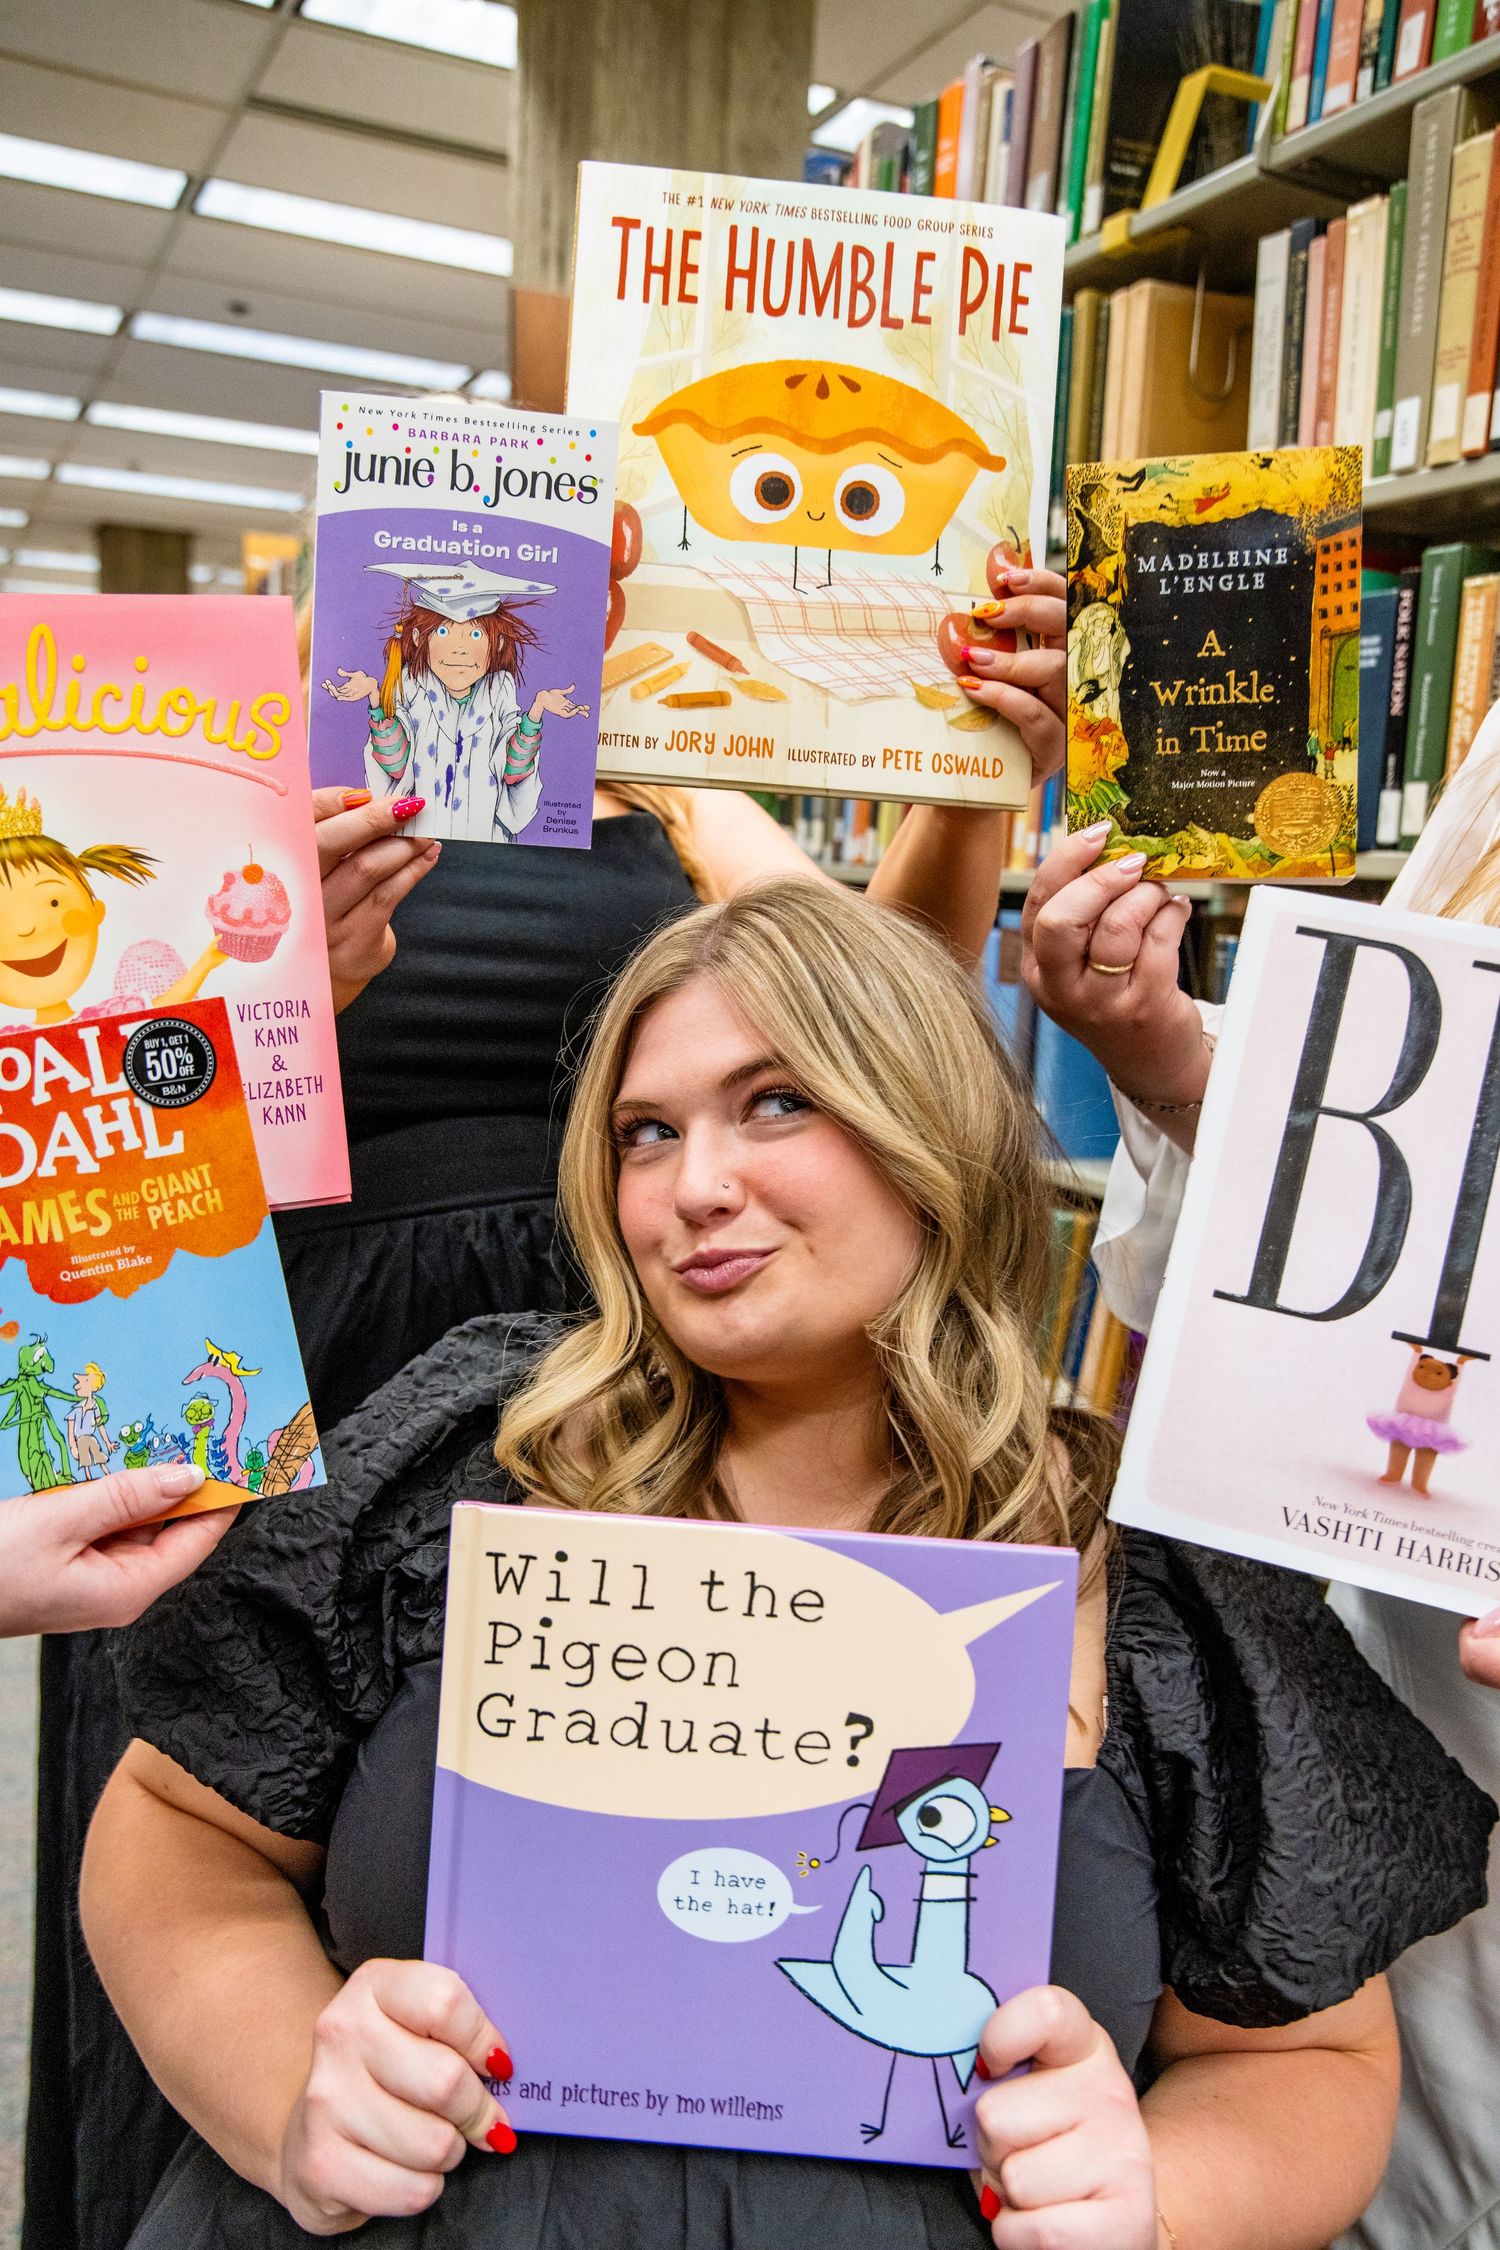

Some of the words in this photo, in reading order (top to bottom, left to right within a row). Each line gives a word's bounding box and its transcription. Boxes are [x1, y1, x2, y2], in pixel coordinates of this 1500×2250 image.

[662, 191, 681, 206] THE
[687, 195, 704, 208] #1
[710, 196, 734, 211] NEW
[739, 199, 768, 215] YORK
[773, 203, 807, 218] TIMES
[810, 206, 878, 226] BESTSELLING
[883, 214, 912, 229] FOOD
[917, 217, 955, 234] GROUP
[959, 222, 994, 239] SERIES
[611, 216, 702, 306] THE
[724, 224, 936, 330] HUMBLE
[958, 246, 1033, 342] PIE
[358, 406, 383, 416] New
[389, 409, 417, 420] York
[422, 412, 459, 424] Times
[464, 417, 536, 434] Bestselling
[541, 424, 581, 437] Series
[408, 427, 482, 445] BARBARA
[489, 436, 530, 450] PARK
[333, 440, 435, 494] junie
[450, 448, 480, 493] b.
[452, 519, 468, 533] Is
[472, 523, 484, 535] a
[373, 530, 510, 559] Graduation
[516, 543, 559, 564] Girl
[1137, 547, 1290, 574] MADELEINE
[1196, 629, 1226, 658] A
[1150, 670, 1276, 708] Wrinkle
[597, 732, 640, 749] RITTEN
[645, 736, 659, 750] BY
[664, 729, 716, 756] JORY
[723, 734, 775, 760] JOHN
[1155, 728, 1181, 755] in
[1190, 720, 1268, 753] Time
[787, 747, 857, 768] ILLUSTRATED
[861, 754, 876, 768] BY
[882, 748, 924, 771] PETE
[931, 753, 1004, 779] OSWALD
[1200, 768, 1219, 778] Now
[1171, 780, 1194, 791] Major
[1196, 780, 1226, 789] Motion
[1227, 779, 1256, 788] Picture
[543, 801, 581, 809] Illustrated
[543, 825, 579, 834] Brunkus
[546, 816, 577, 825] Denise
[236, 999, 311, 1023] VICTORIA
[144, 1038, 159, 1049] BUY
[160, 1037, 168, 1048] 1,
[169, 1034, 183, 1046] GET
[184, 1034, 189, 1043] 1
[254, 1025, 299, 1048] KANN
[0, 1019, 154, 1108] OAL
[145, 1046, 194, 1081] 50%
[179, 1064, 195, 1077] OFF
[271, 1054, 288, 1072] &
[162, 1084, 187, 1096] B&N
[263, 1103, 307, 1125] KANN
[0, 1097, 184, 1189] DAHL
[112, 1191, 140, 1209] AND
[141, 1163, 211, 1204] GIANT
[115, 1207, 140, 1222] THE
[146, 1188, 224, 1230] PEACH
[60, 1261, 115, 1282] Quentin
[117, 1254, 153, 1271] Blake
[70, 1245, 122, 1265] Illustrated
[123, 1244, 136, 1256] by
[1281, 1505, 1385, 1552] VASHTI
[1312, 1496, 1338, 1511] New
[1341, 1502, 1369, 1520] York
[1372, 1510, 1409, 1529] Times
[1410, 1521, 1475, 1549] bestselling
[486, 1550, 657, 1612] Will
[700, 1570, 826, 1623] the
[484, 1617, 740, 1689] Pigeon
[476, 1692, 875, 1768] Graduate?
[690, 1870, 700, 1887] I
[714, 1871, 767, 1890] have
[673, 1895, 713, 1915] the
[728, 1897, 775, 1917] hat!
[519, 2081, 552, 2101] and
[561, 2083, 640, 2108] pictures
[645, 2089, 669, 2116] by
[676, 2094, 705, 2115] mo
[710, 2096, 785, 2121] willems
